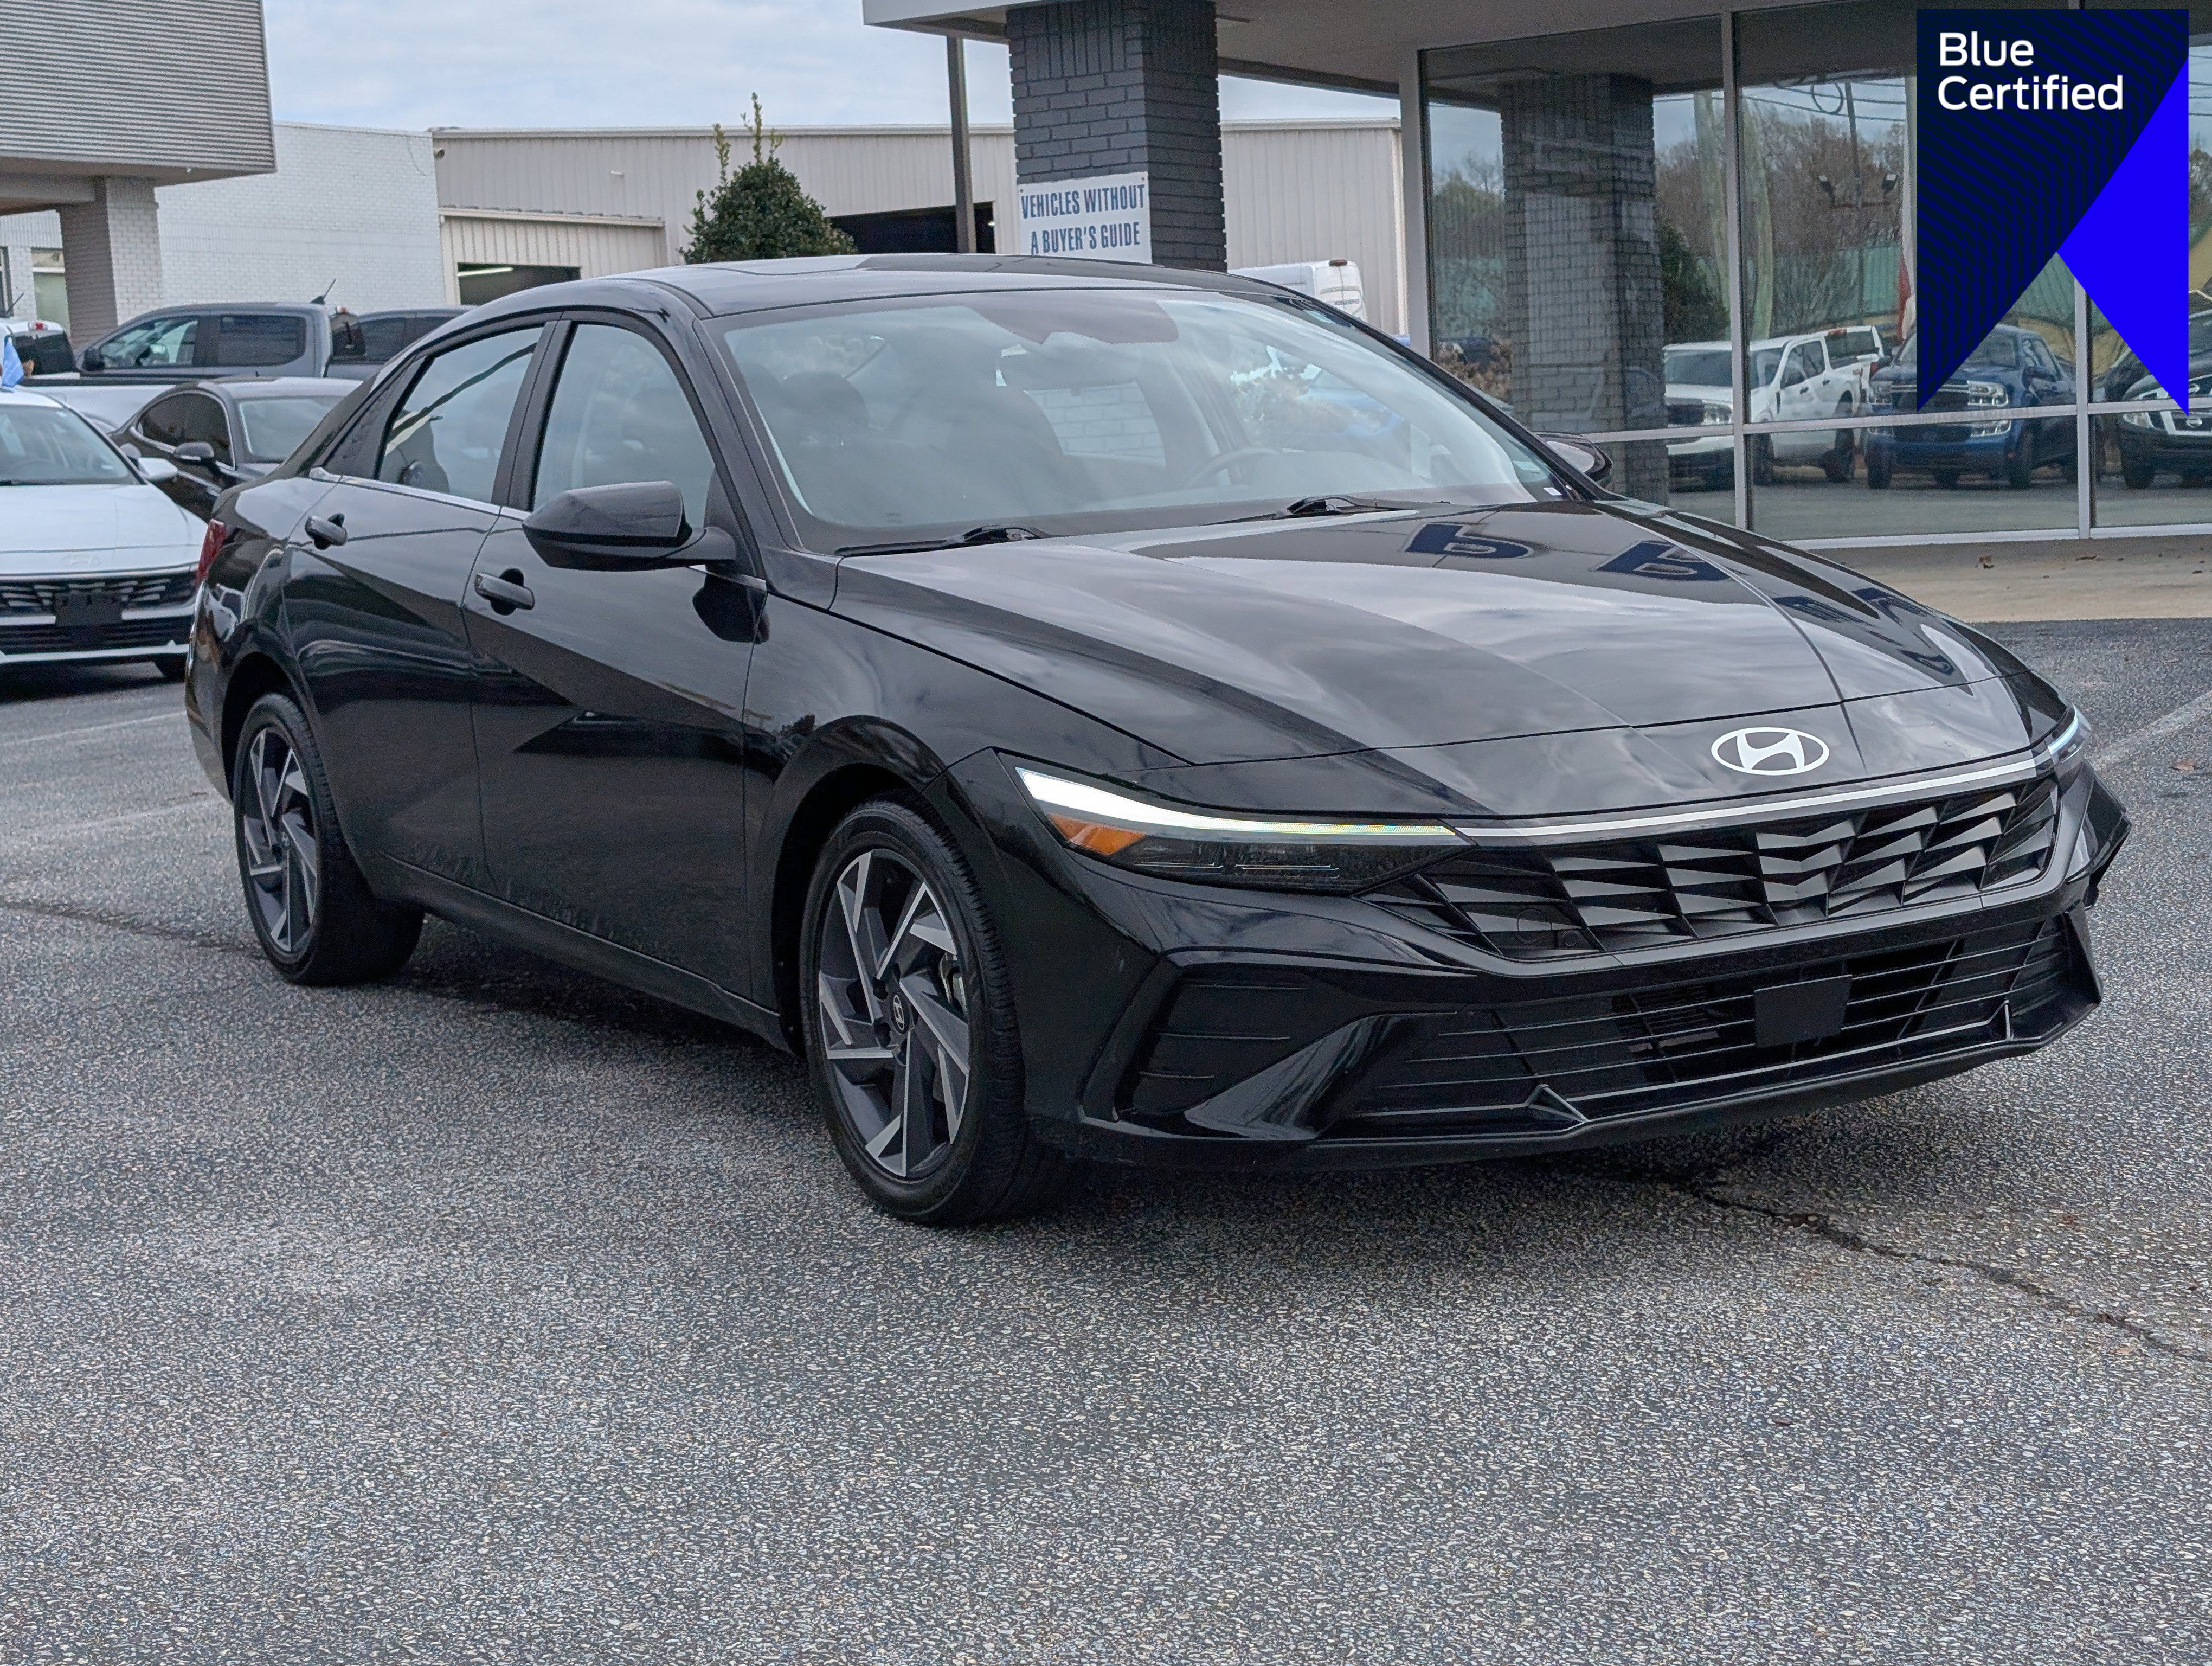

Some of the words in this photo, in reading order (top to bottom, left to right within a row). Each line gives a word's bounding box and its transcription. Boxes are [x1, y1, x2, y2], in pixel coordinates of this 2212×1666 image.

[1021, 190, 1081, 219] VEHICLES
[1083, 184, 1145, 213] WITHOUT
[1031, 230, 1039, 255] A
[1042, 225, 1096, 253] BUYER'S
[1101, 221, 1140, 248] GUIDE
